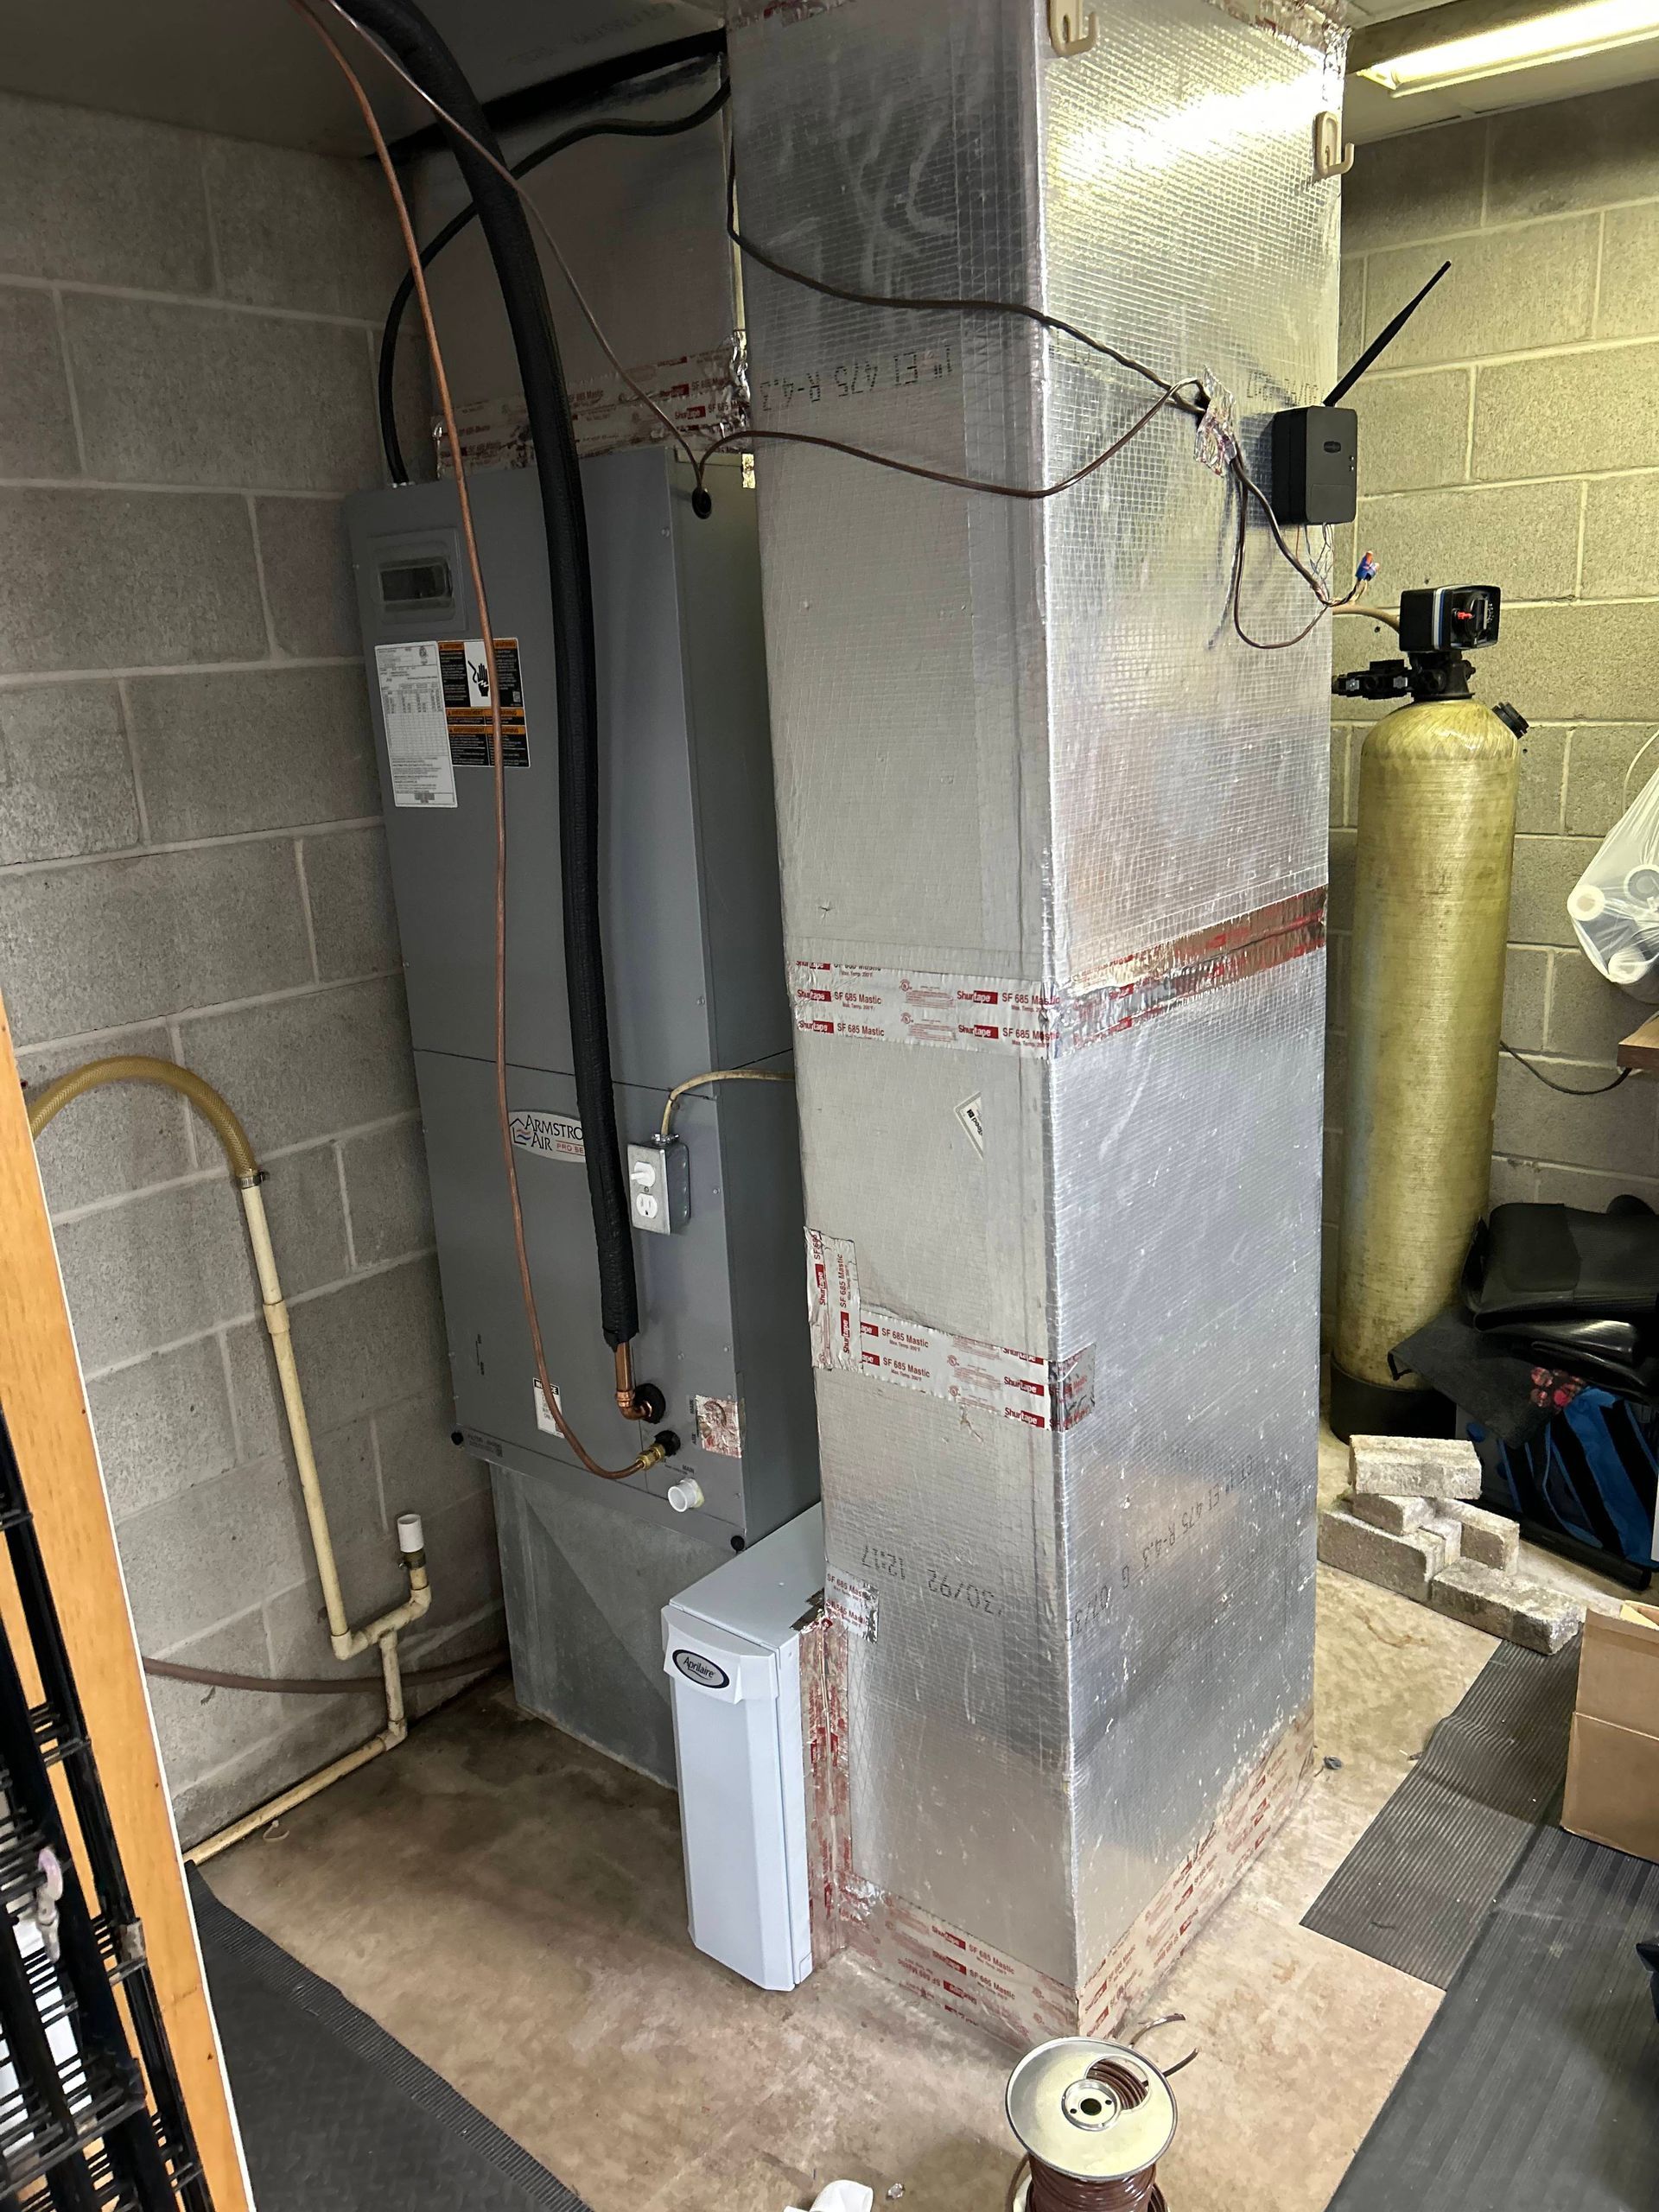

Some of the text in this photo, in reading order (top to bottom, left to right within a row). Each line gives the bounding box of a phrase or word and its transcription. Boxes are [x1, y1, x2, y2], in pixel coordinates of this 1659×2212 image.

[835, 361, 878, 397] 475
[760, 372, 821, 412] R-4.3
[845, 994, 857, 1002] 685
[859, 995, 882, 1005] Mastic
[957, 991, 992, 1003] Shurtape
[1002, 993, 1013, 1002] SF
[1014, 995, 1029, 1004] 685
[837, 1024, 846, 1033] SF
[848, 1026, 860, 1034] 685
[861, 1027, 885, 1037] Mastic
[958, 1025, 992, 1037] Shurtape
[1002, 1027, 1014, 1037] SF
[1015, 1029, 1030, 1039] 685
[531, 1131, 552, 1151] AIR
[556, 1143, 572, 1152] PRO
[817, 1271, 826, 1306] Shurtape
[839, 1296, 847, 1308] SF
[893, 1331, 904, 1341] 685
[906, 1335, 929, 1348] Mastic
[883, 1357, 892, 1366] SF
[893, 1360, 906, 1371] 685
[907, 1364, 930, 1377] Mastic
[1004, 1376, 1037, 1393] Shurtape
[1005, 1408, 1038, 1424] Shurtape
[1181, 1502, 1204, 1534] 475
[1142, 1522, 1176, 1569] R-4.3
[827, 1573, 836, 1583] SF
[836, 1579, 848, 1590] 685
[683, 1656, 715, 1679] Aprilaire
[969, 1944, 978, 1954] SF
[979, 1950, 992, 1961] 685
[993, 1957, 1015, 1974] Mastic
[969, 1969, 978, 1979] SF
[980, 1975, 992, 1987] 685
[993, 1982, 1016, 2000] Mastic
